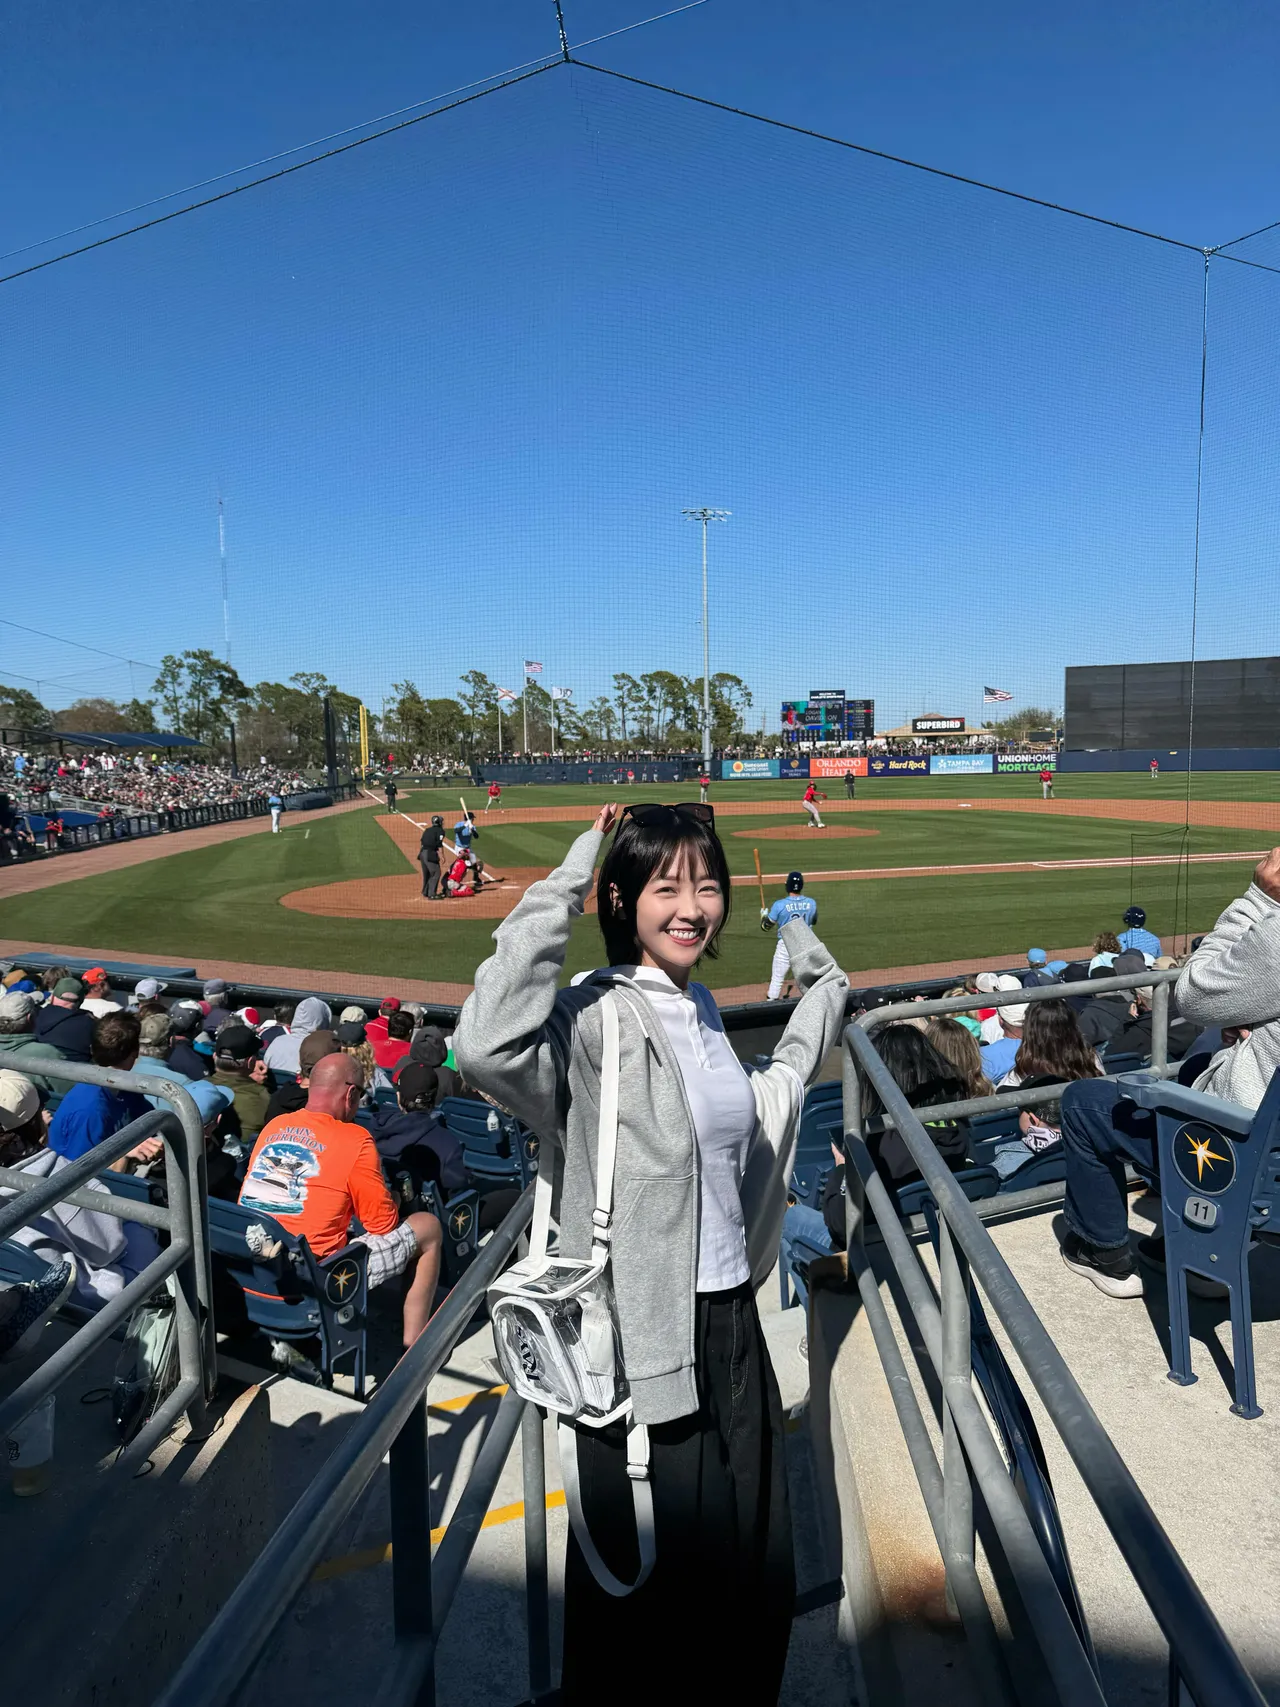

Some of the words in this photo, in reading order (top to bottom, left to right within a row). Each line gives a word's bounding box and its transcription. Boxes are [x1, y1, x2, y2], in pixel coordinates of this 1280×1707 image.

[916, 720, 961, 730] SUPERBIRD
[816, 759, 861, 768] ORLANDO
[888, 760, 908, 769] Hard
[908, 760, 927, 770] Rock
[997, 763, 1057, 771] MORTGAGE
[821, 768, 857, 777] HEALTH
[785, 902, 811, 912] DELUCA
[284, 1126, 312, 1136] MAIN
[265, 1133, 327, 1153] ATTRACTION
[1193, 1202, 1209, 1220] 11
